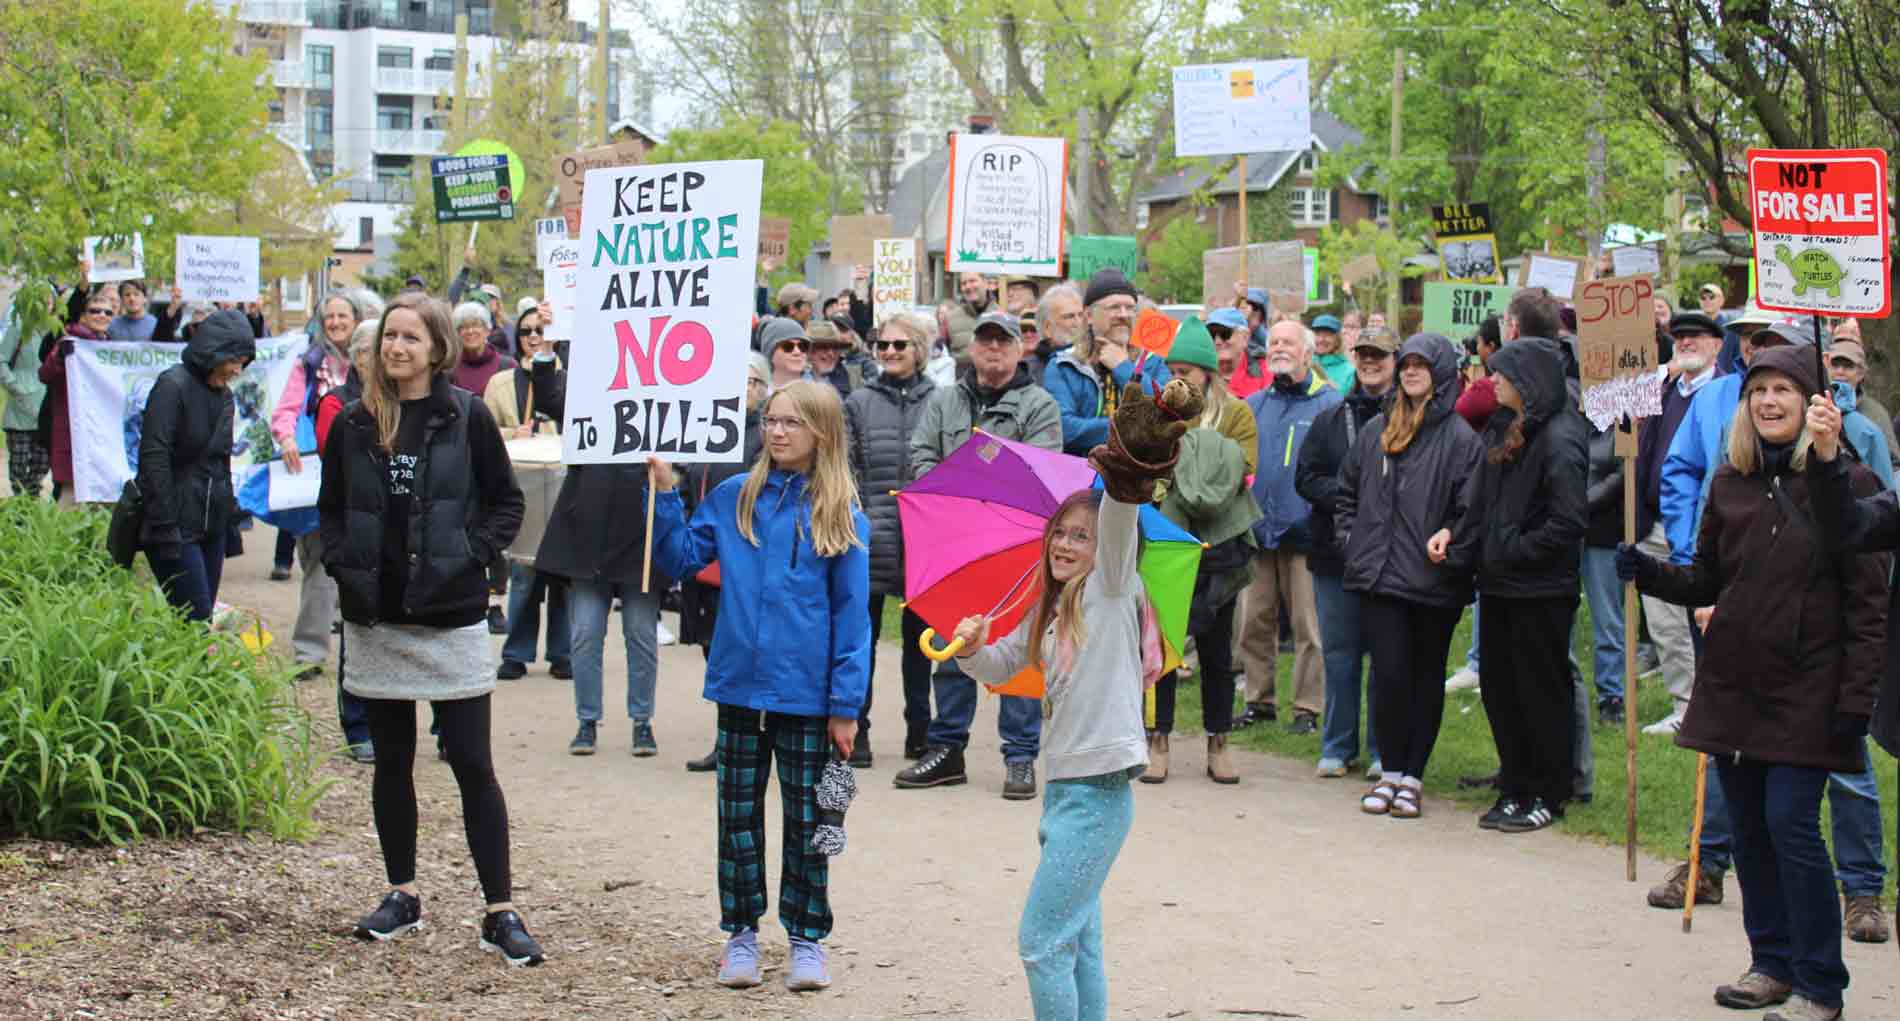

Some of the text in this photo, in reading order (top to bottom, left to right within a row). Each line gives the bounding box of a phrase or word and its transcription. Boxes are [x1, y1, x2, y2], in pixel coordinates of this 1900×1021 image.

[983, 152, 1023, 172] RIP
[1778, 162, 1828, 189] NOT
[612, 171, 706, 218] KEEP
[1757, 190, 1874, 222] FOR SALE
[592, 213, 739, 267] NATURE
[880, 241, 904, 257] IF
[877, 258, 912, 273] YOU
[600, 264, 710, 311] ALIVE
[1454, 289, 1493, 307] STOP
[1582, 280, 1652, 323] STOP
[606, 315, 714, 392] NO
[612, 397, 740, 456] BILL-5
